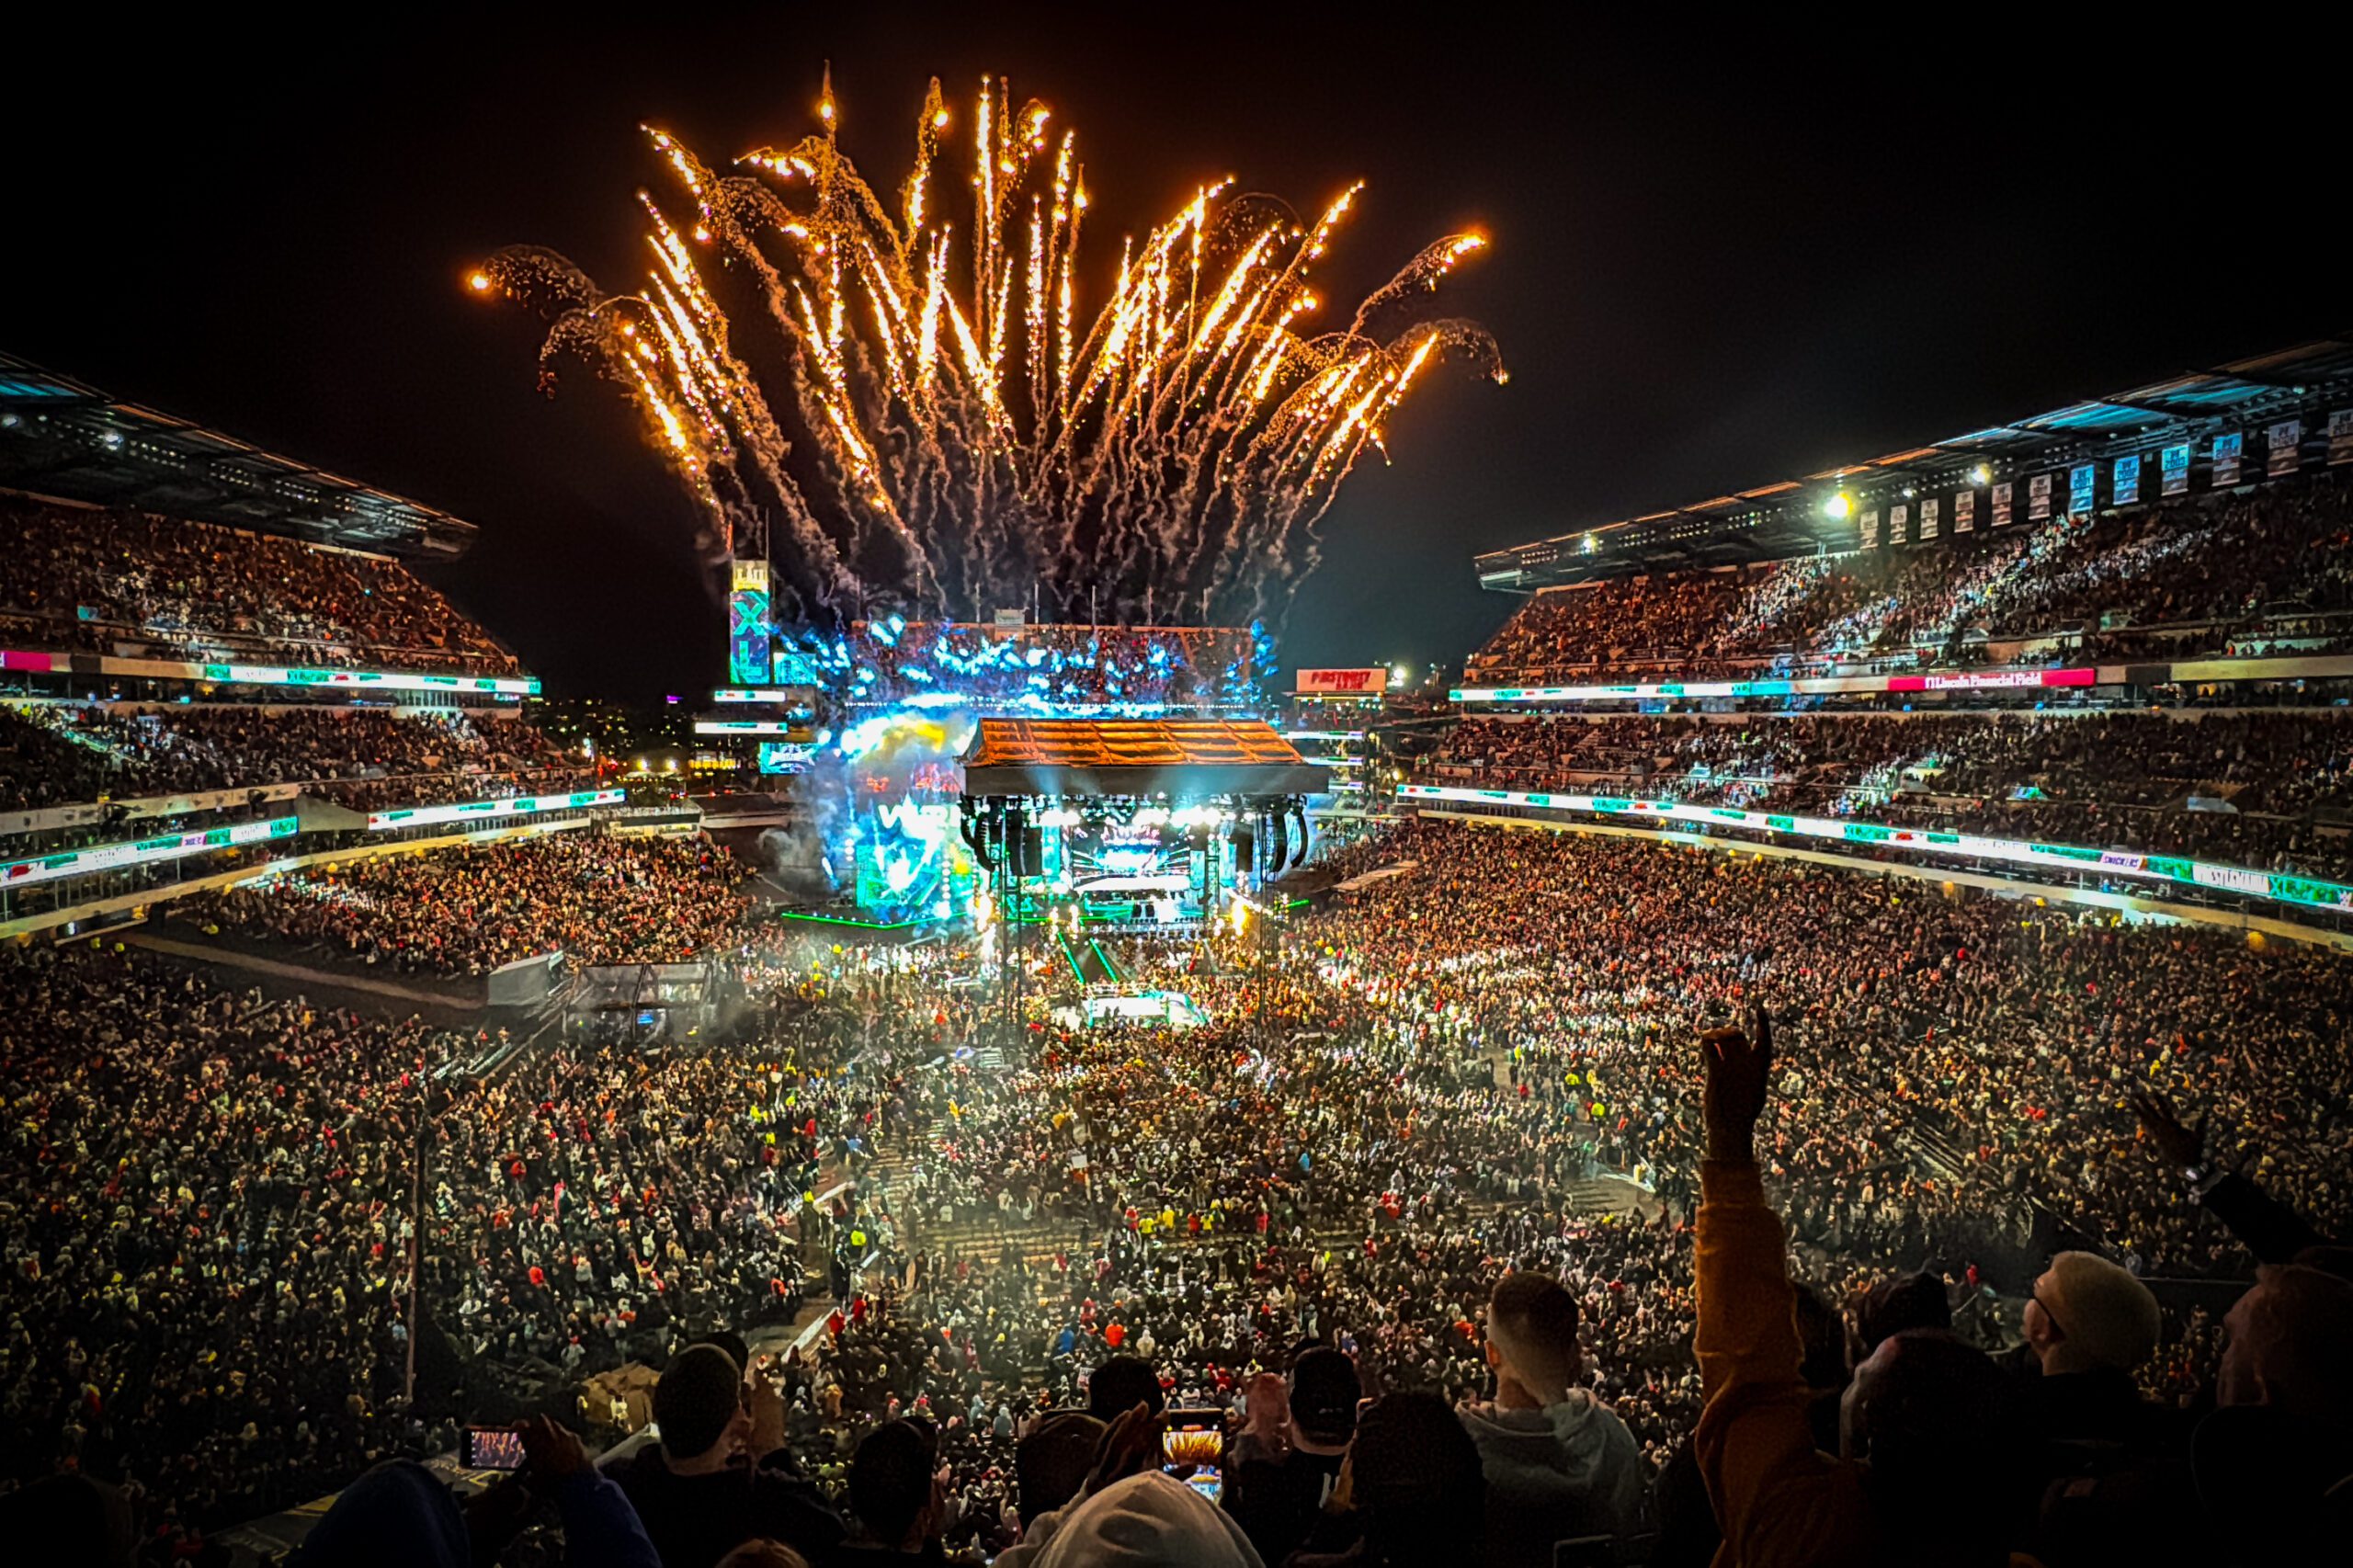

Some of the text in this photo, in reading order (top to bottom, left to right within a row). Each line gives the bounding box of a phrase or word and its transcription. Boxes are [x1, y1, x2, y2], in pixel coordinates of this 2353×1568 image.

[1935, 672, 2041, 689] Lincoln Financial Field
